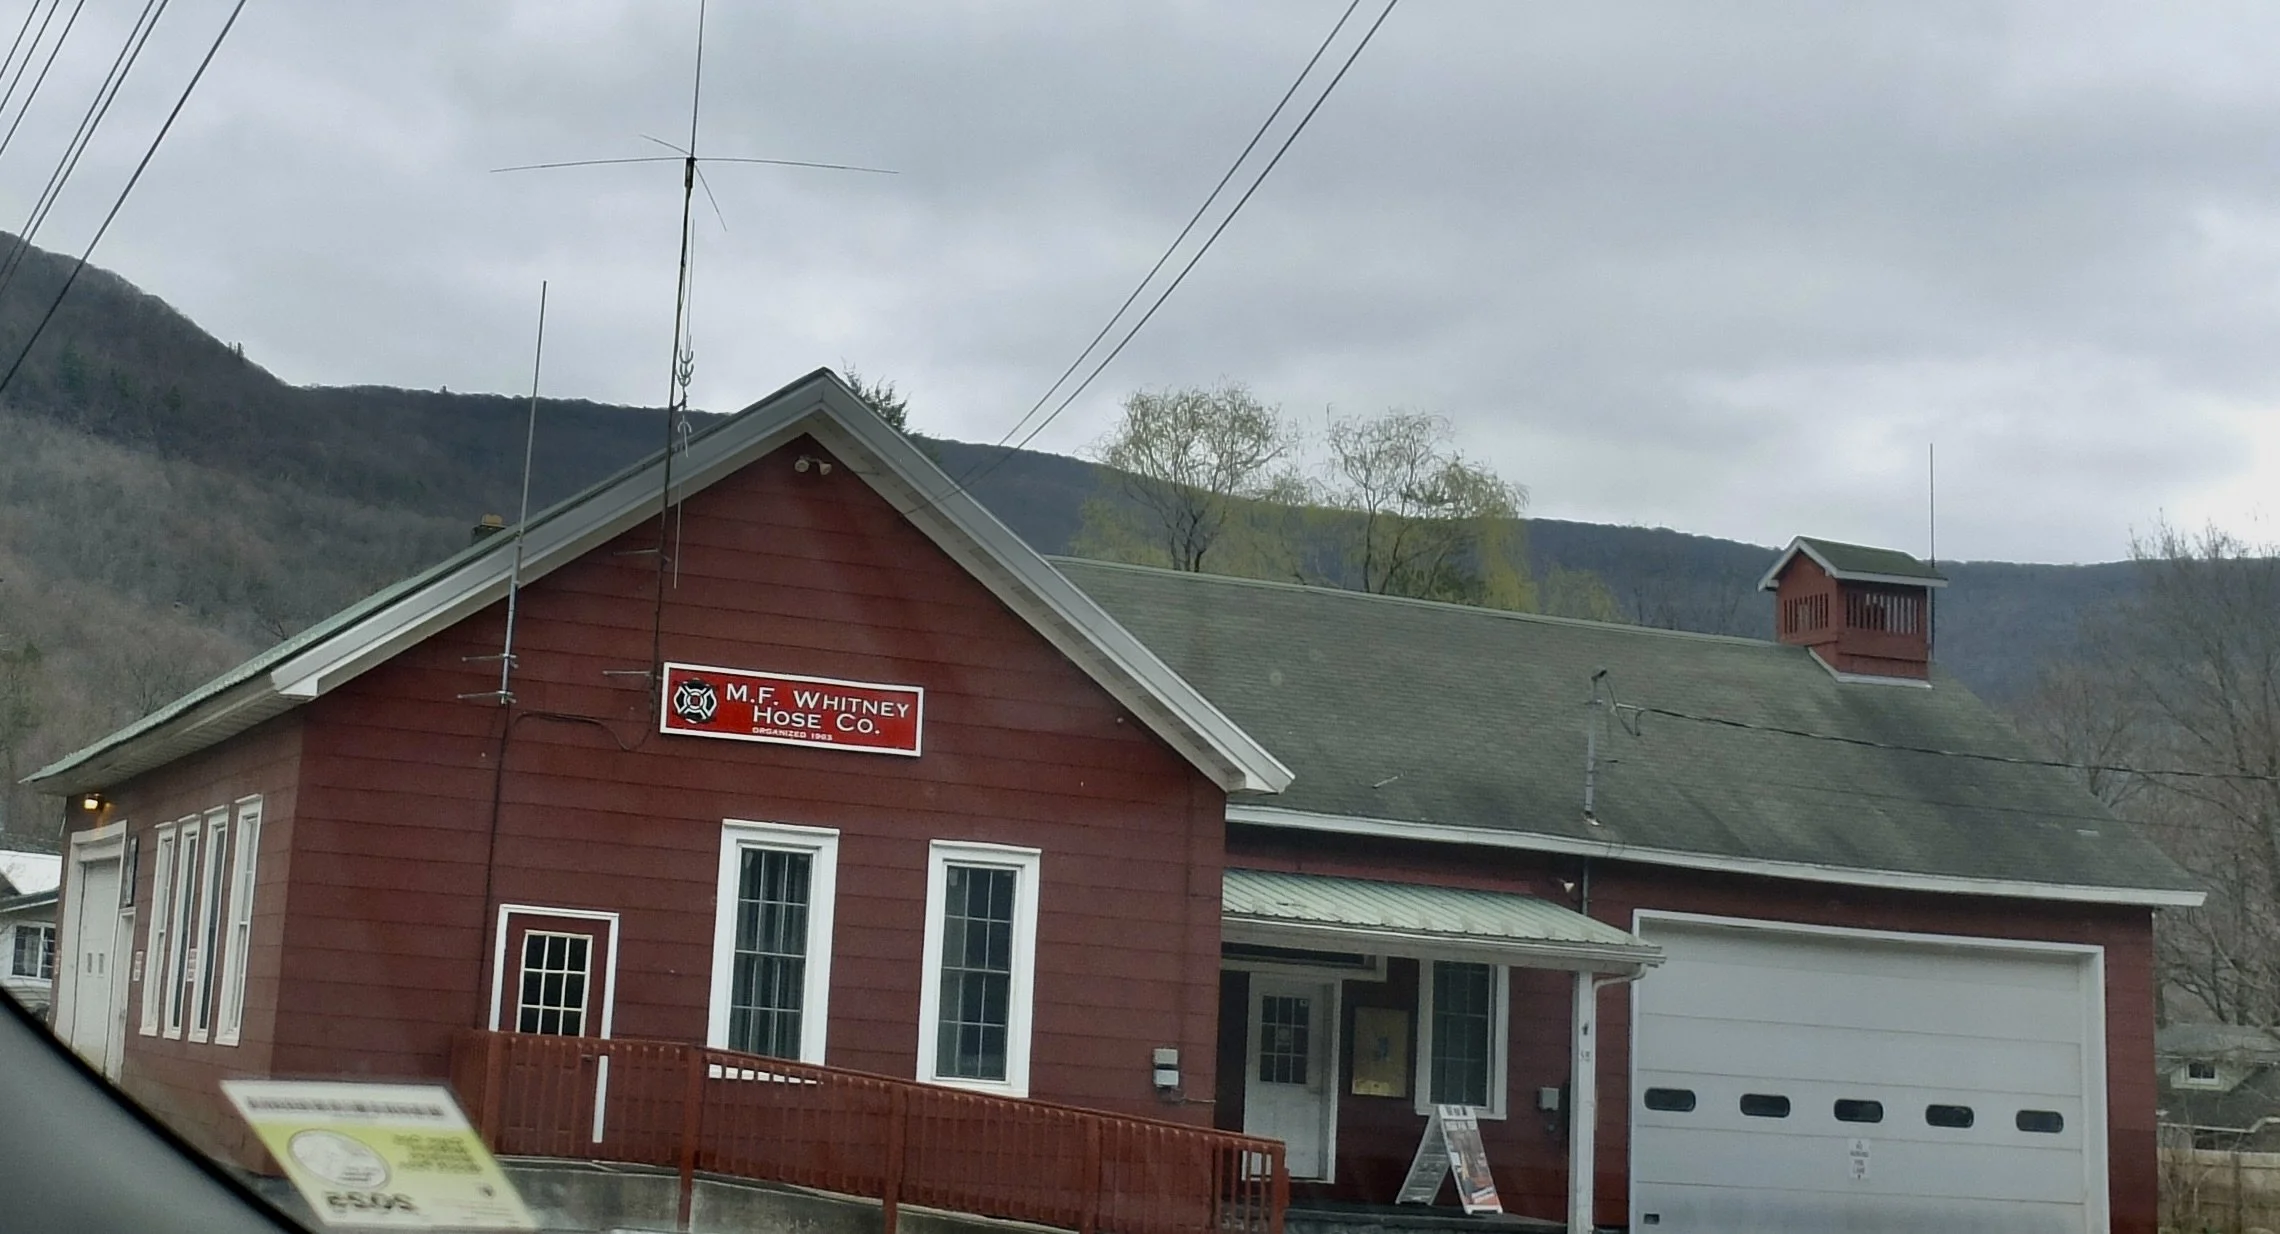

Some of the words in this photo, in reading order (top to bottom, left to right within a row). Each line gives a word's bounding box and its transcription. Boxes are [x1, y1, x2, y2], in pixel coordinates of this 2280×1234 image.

[726, 683, 779, 706] M.F.
[793, 690, 909, 718] WHITNEY
[752, 727, 807, 738] ORGANIZED
[753, 705, 822, 729] HOSE
[836, 713, 881, 734] CO.
